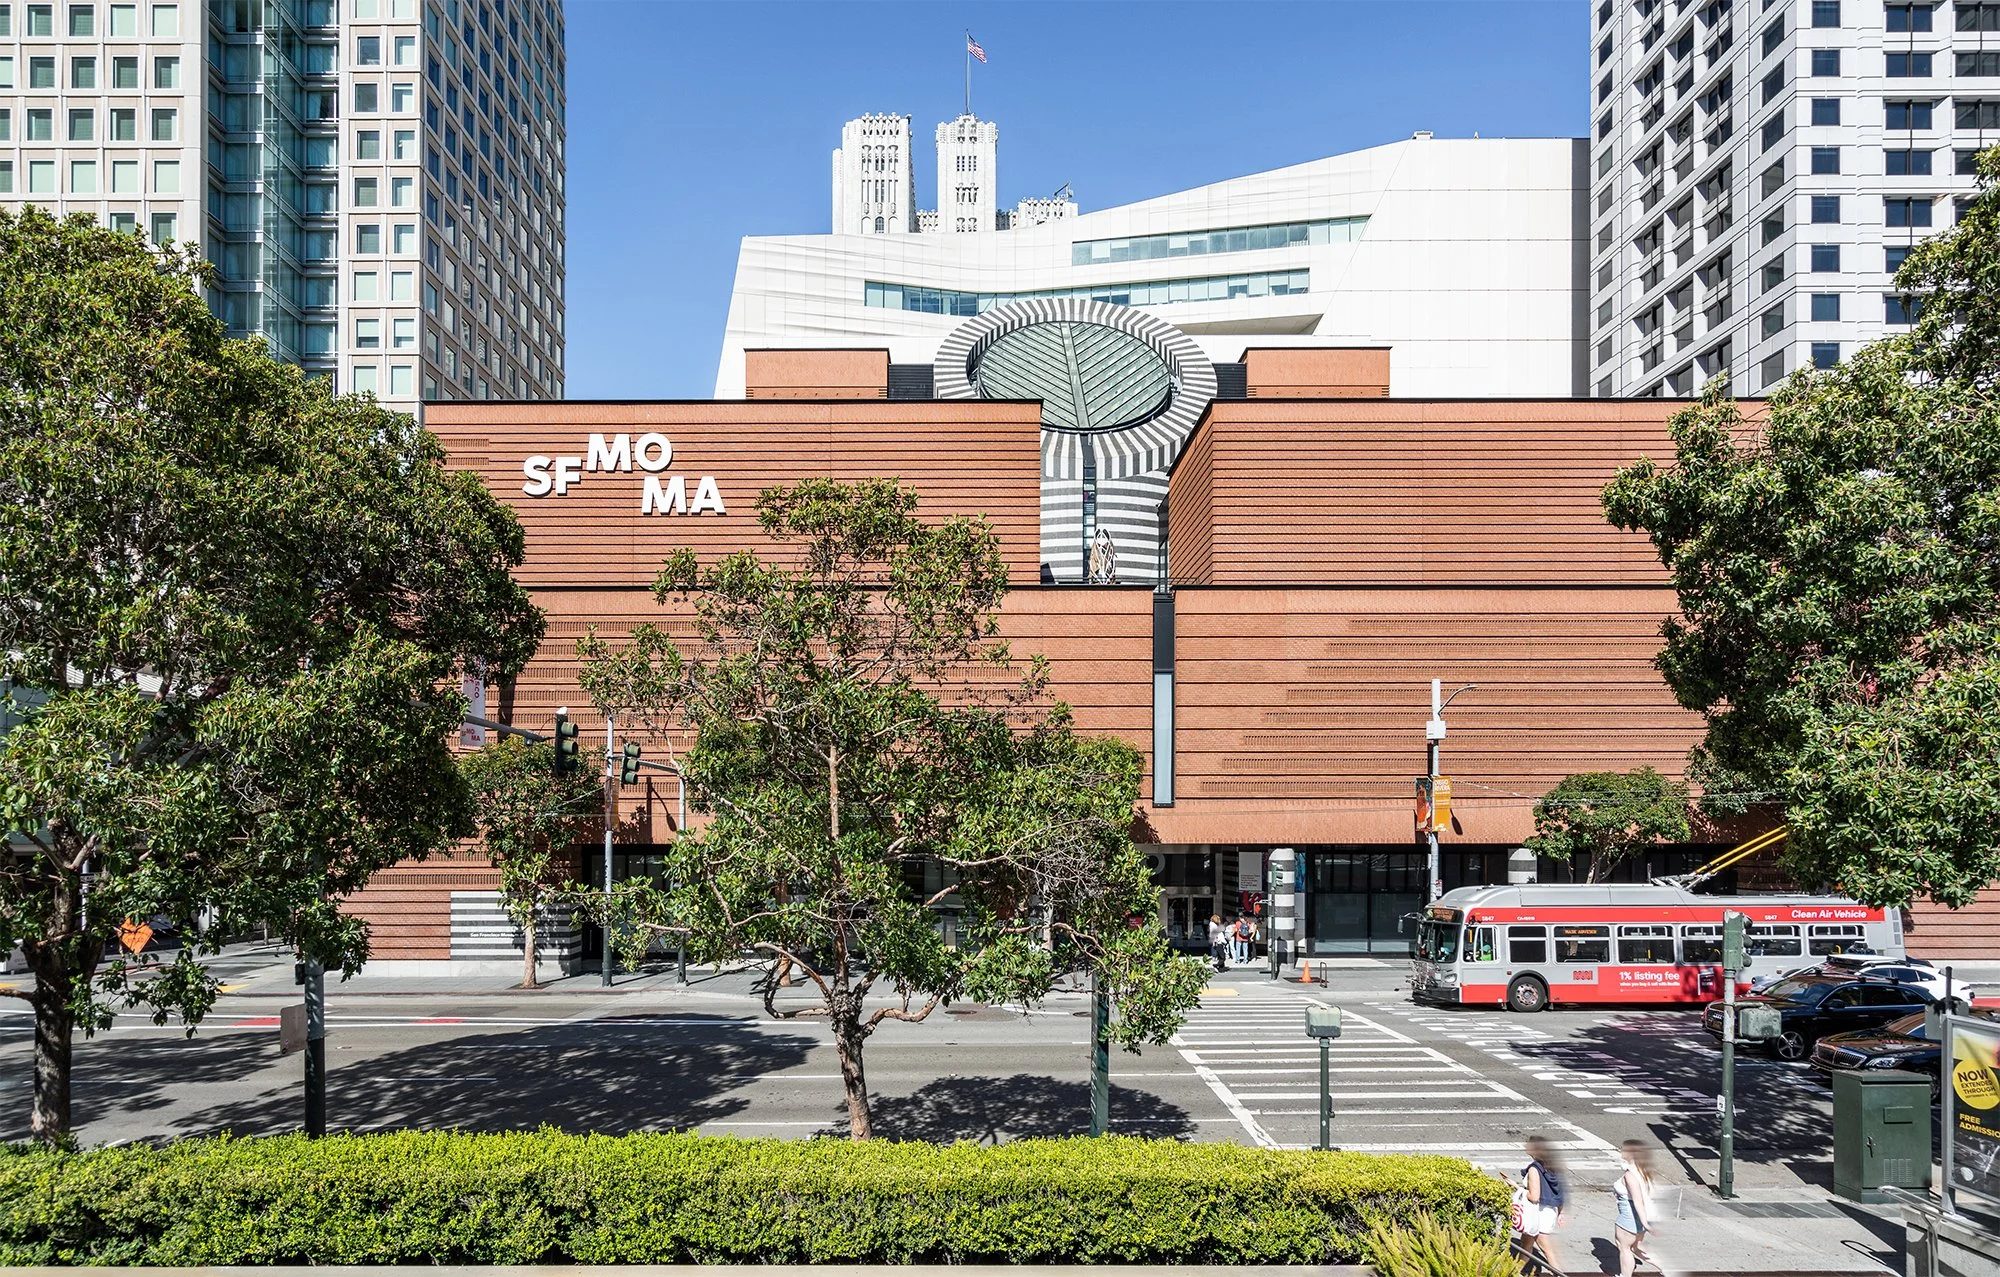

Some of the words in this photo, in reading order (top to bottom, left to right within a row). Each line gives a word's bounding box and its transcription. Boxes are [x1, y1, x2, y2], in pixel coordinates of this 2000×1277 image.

[1791, 909, 1817, 919] Clean
[1819, 909, 1832, 919] Air
[1833, 909, 1867, 919] Vehicle
[1619, 971, 1633, 980] 1%
[1634, 971, 1662, 982] listing
[1664, 971, 1680, 980] fee
[1957, 1069, 1989, 1082] NOW
[1961, 1080, 1993, 1089] EXTENDED
[1963, 1086, 1996, 1095] THROUGH
[1959, 1113, 1981, 1125] FREE
